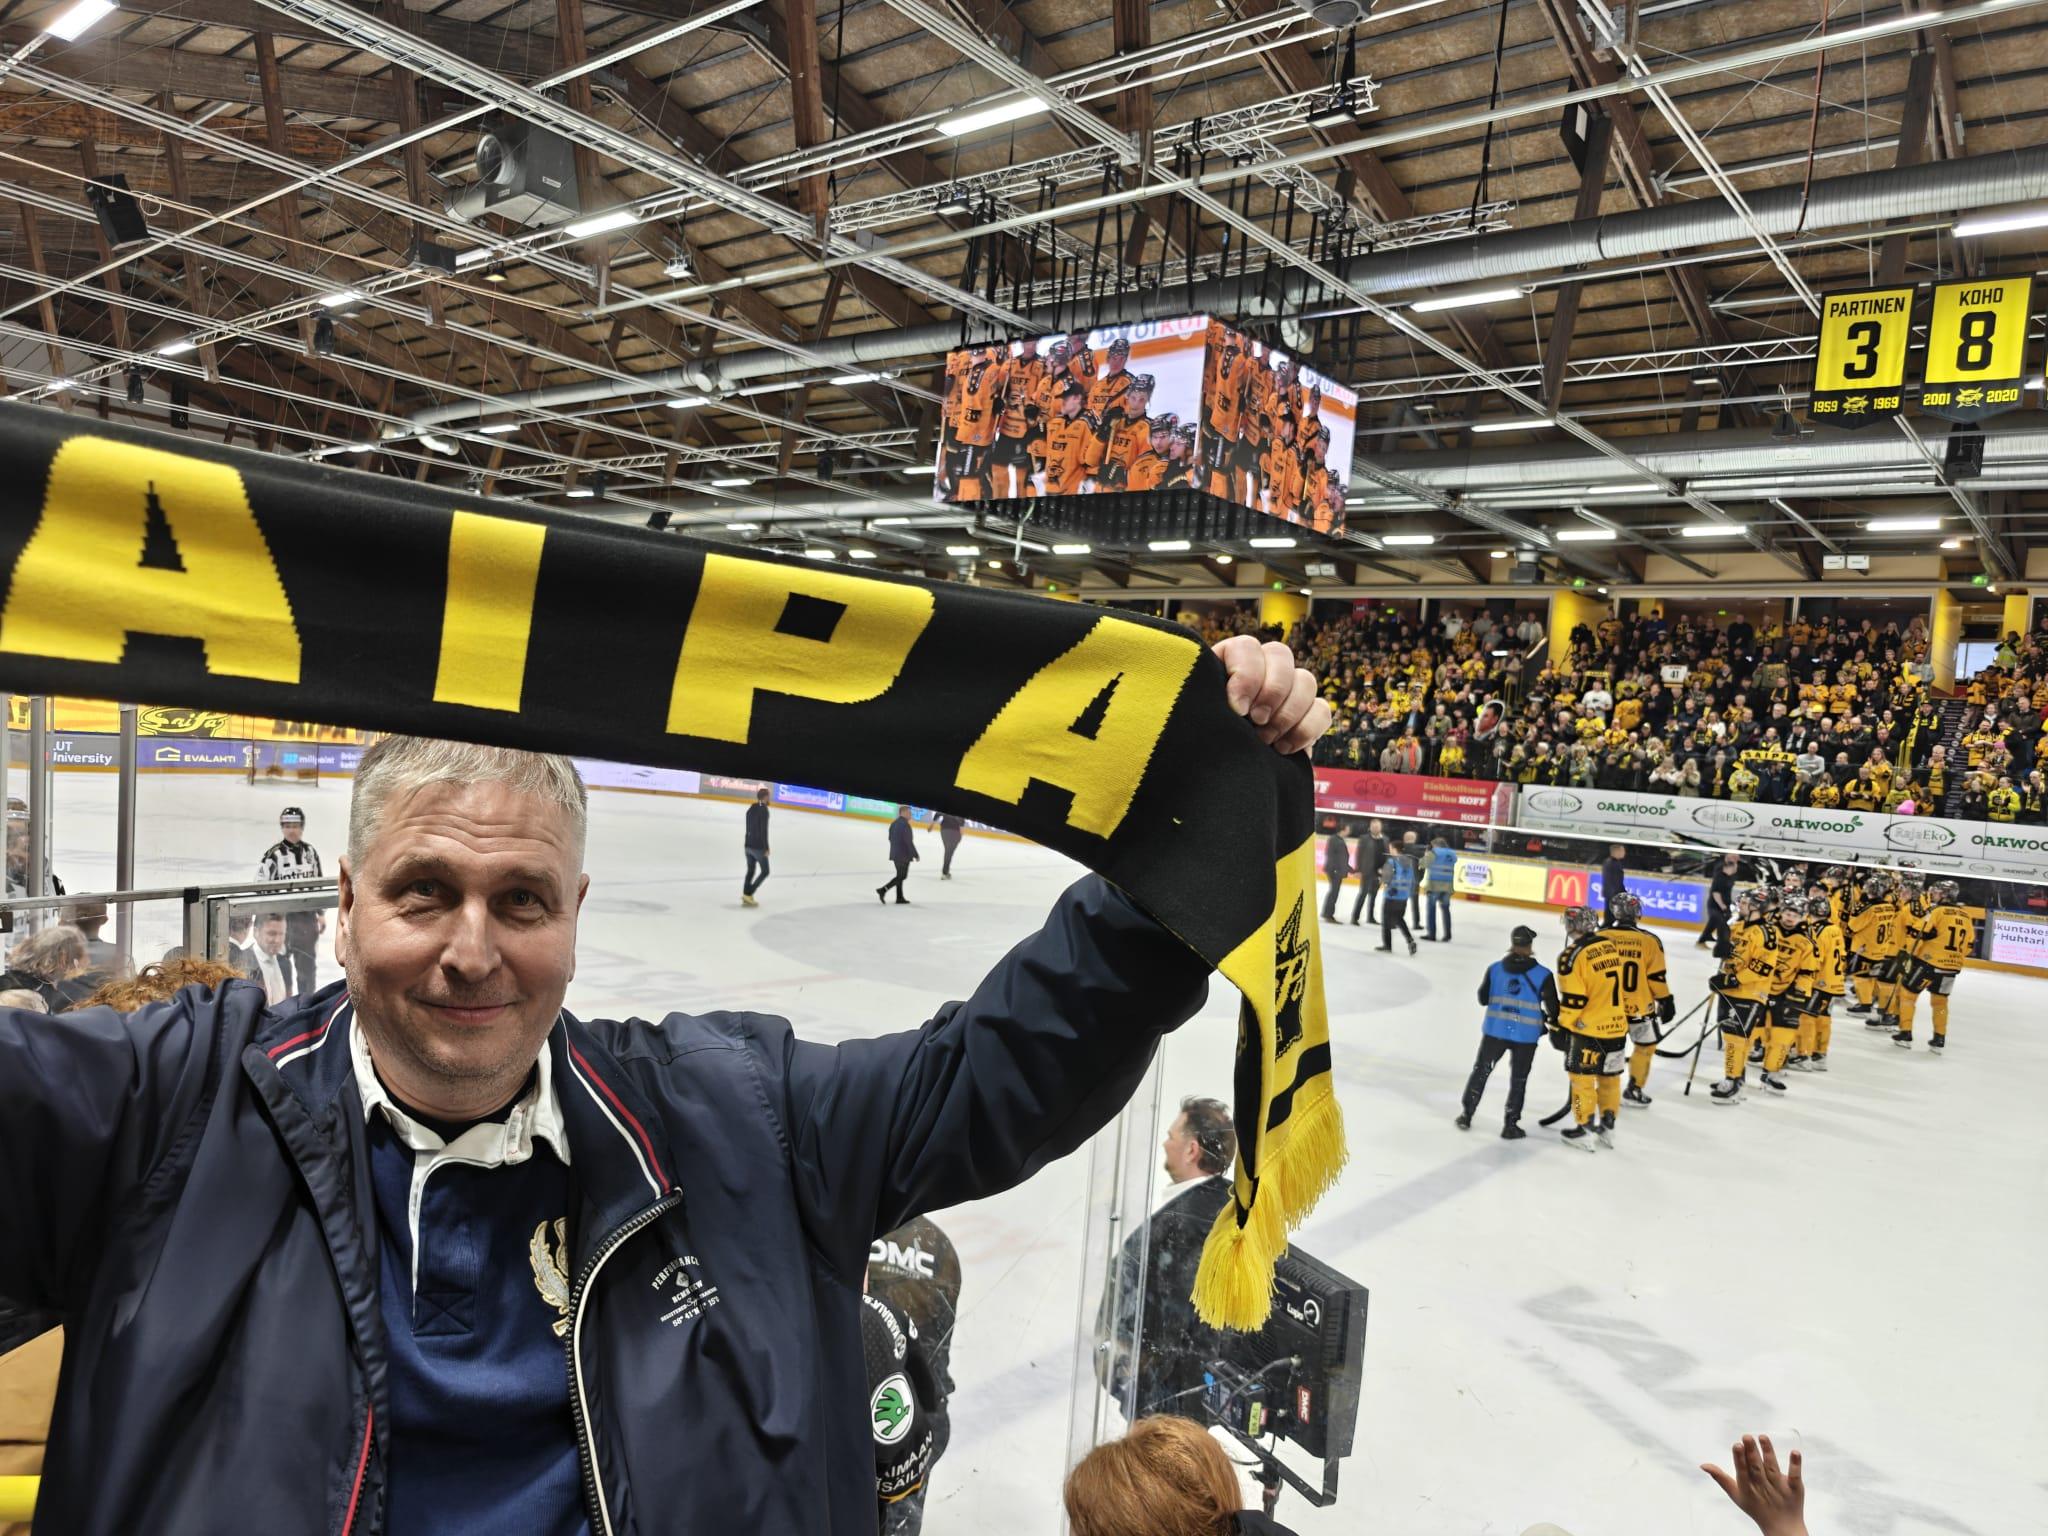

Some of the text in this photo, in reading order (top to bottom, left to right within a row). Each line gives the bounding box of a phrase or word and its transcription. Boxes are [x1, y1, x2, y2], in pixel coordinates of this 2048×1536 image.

[1959, 287, 2004, 306] KOHO
[1830, 296, 1906, 318] PARTINEN
[1956, 310, 1997, 372] 8
[1843, 320, 1882, 380] 3
[1813, 396, 1899, 413] 1959 1969
[1922, 388, 2019, 406] 2001 2020
[53, 741, 73, 752] UT
[184, 753, 236, 764] EVALAHTI
[1745, 751, 1789, 761] SAIPA
[1458, 795, 1488, 806] KOFF
[1375, 804, 1399, 813] KOFF
[1416, 808, 1441, 818] KOFF
[1597, 801, 1669, 816] OAKWOOD
[1460, 813, 1485, 823] KOFF
[1771, 817, 1855, 833] OAKWOOD
[1894, 826, 1948, 842] RajaEko
[2001, 933, 2045, 946] Huhtari
